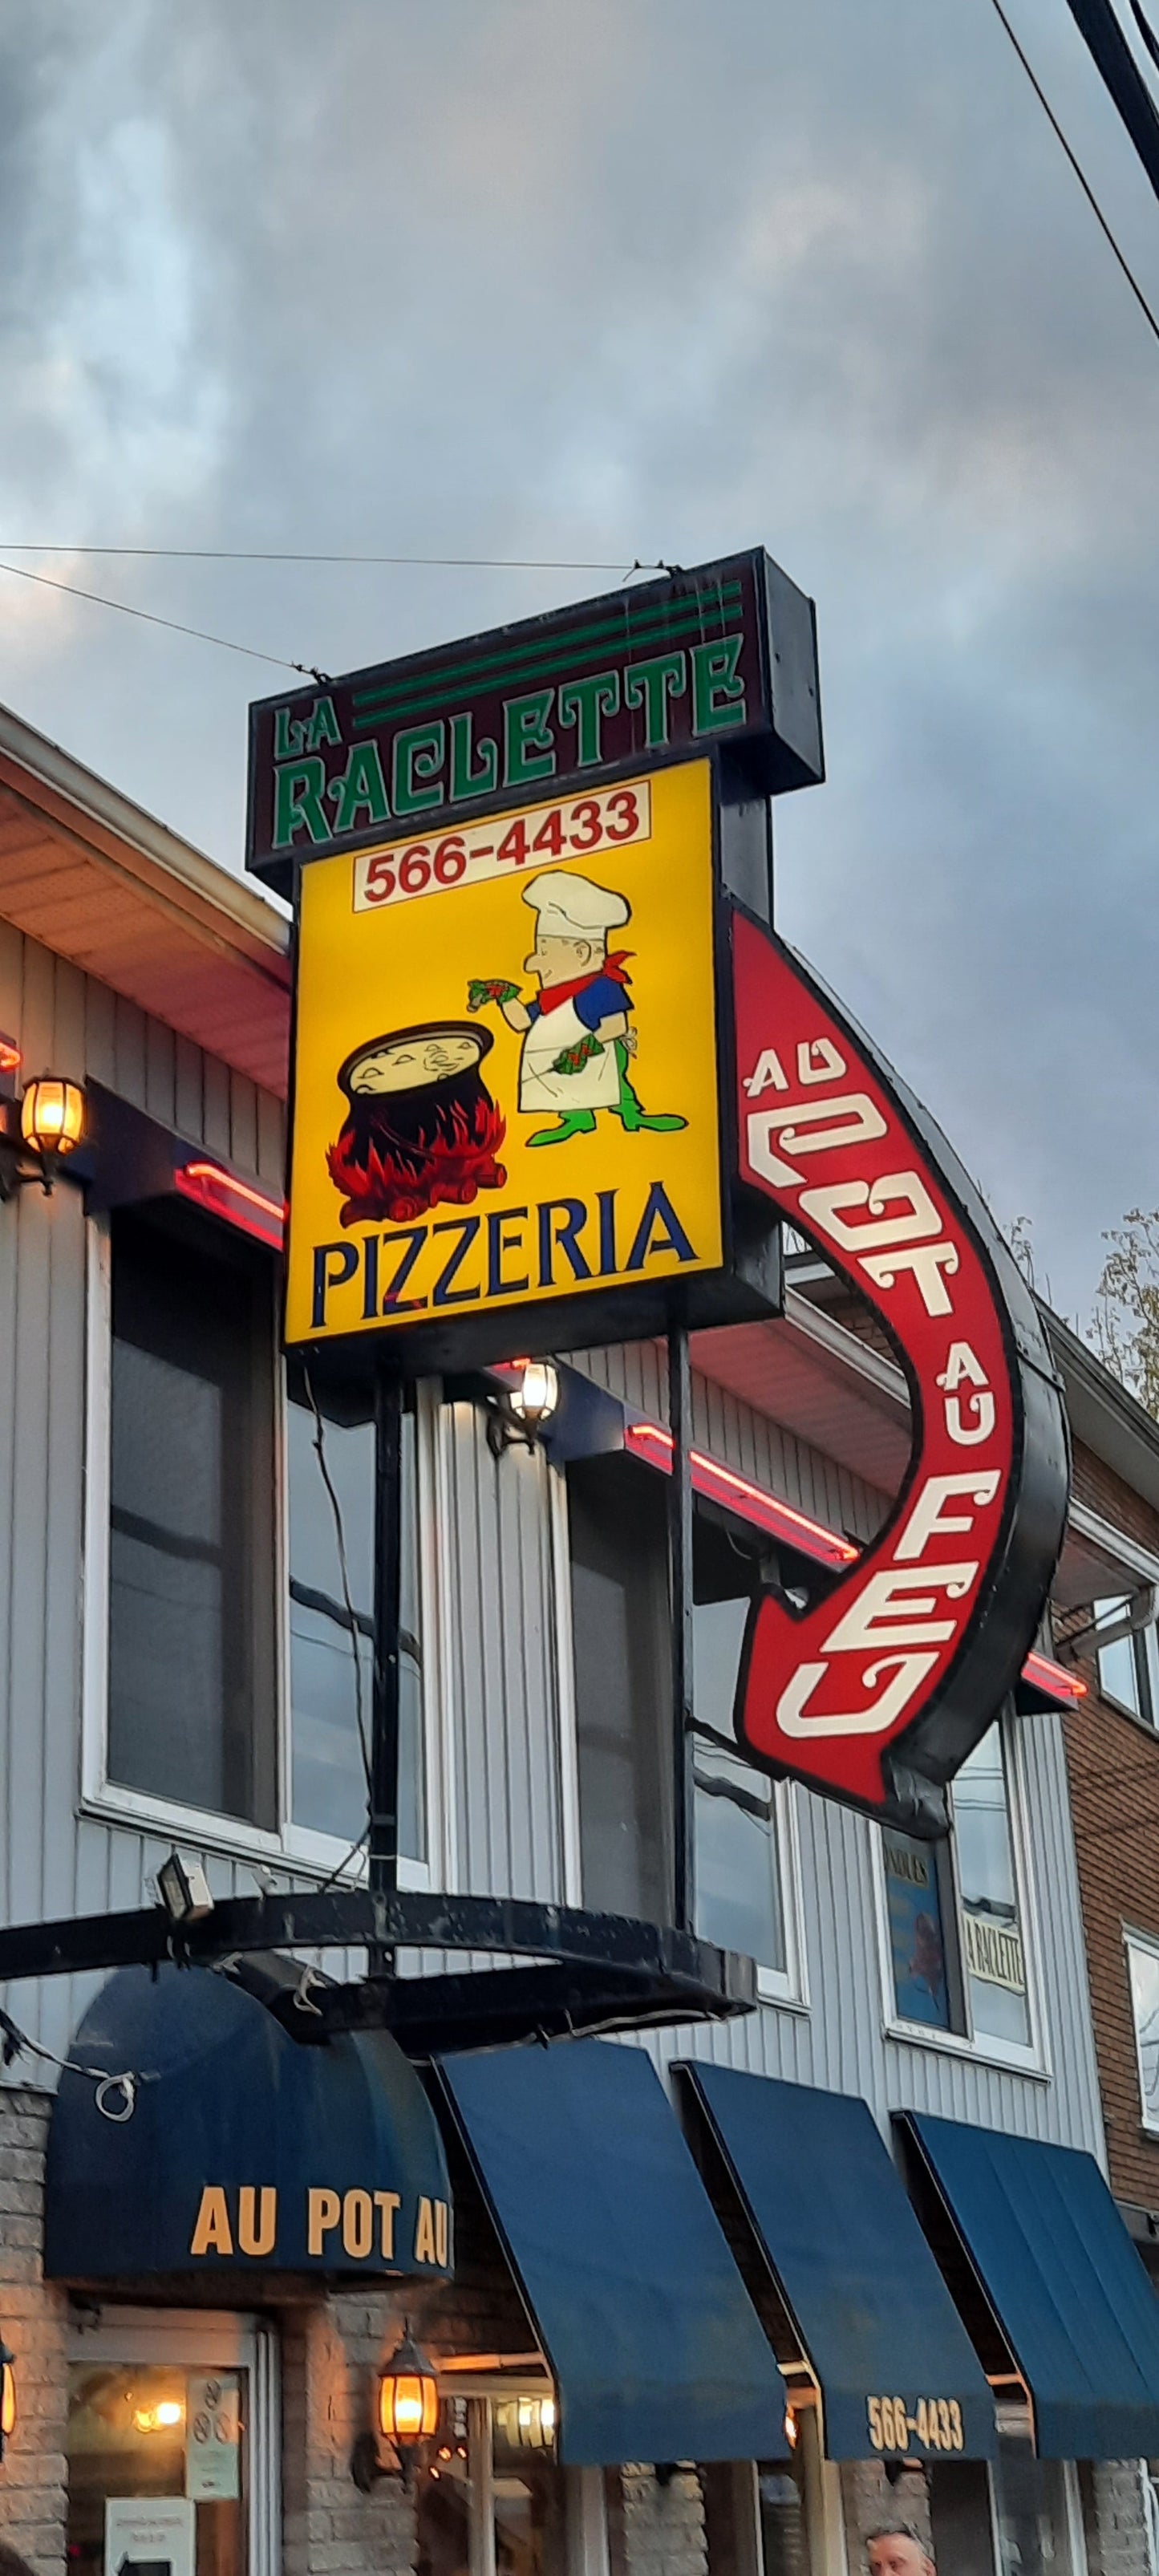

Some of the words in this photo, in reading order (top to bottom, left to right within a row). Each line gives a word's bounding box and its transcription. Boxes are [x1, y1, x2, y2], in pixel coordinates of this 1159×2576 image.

[270, 632, 748, 850] RACLETTE
[274, 696, 342, 761] LA
[363, 790, 642, 903] 566-4433
[743, 1037, 848, 1098] AU
[310, 1181, 702, 1330] PIZZERIA
[746, 1092, 960, 1318] POT
[936, 1341, 996, 1446] AU
[776, 1469, 1002, 1738] FEU
[190, 2186, 278, 2256] AU
[307, 2187, 400, 2261] POT
[414, 2194, 448, 2270] AU
[866, 2395, 964, 2452] 566-4433
